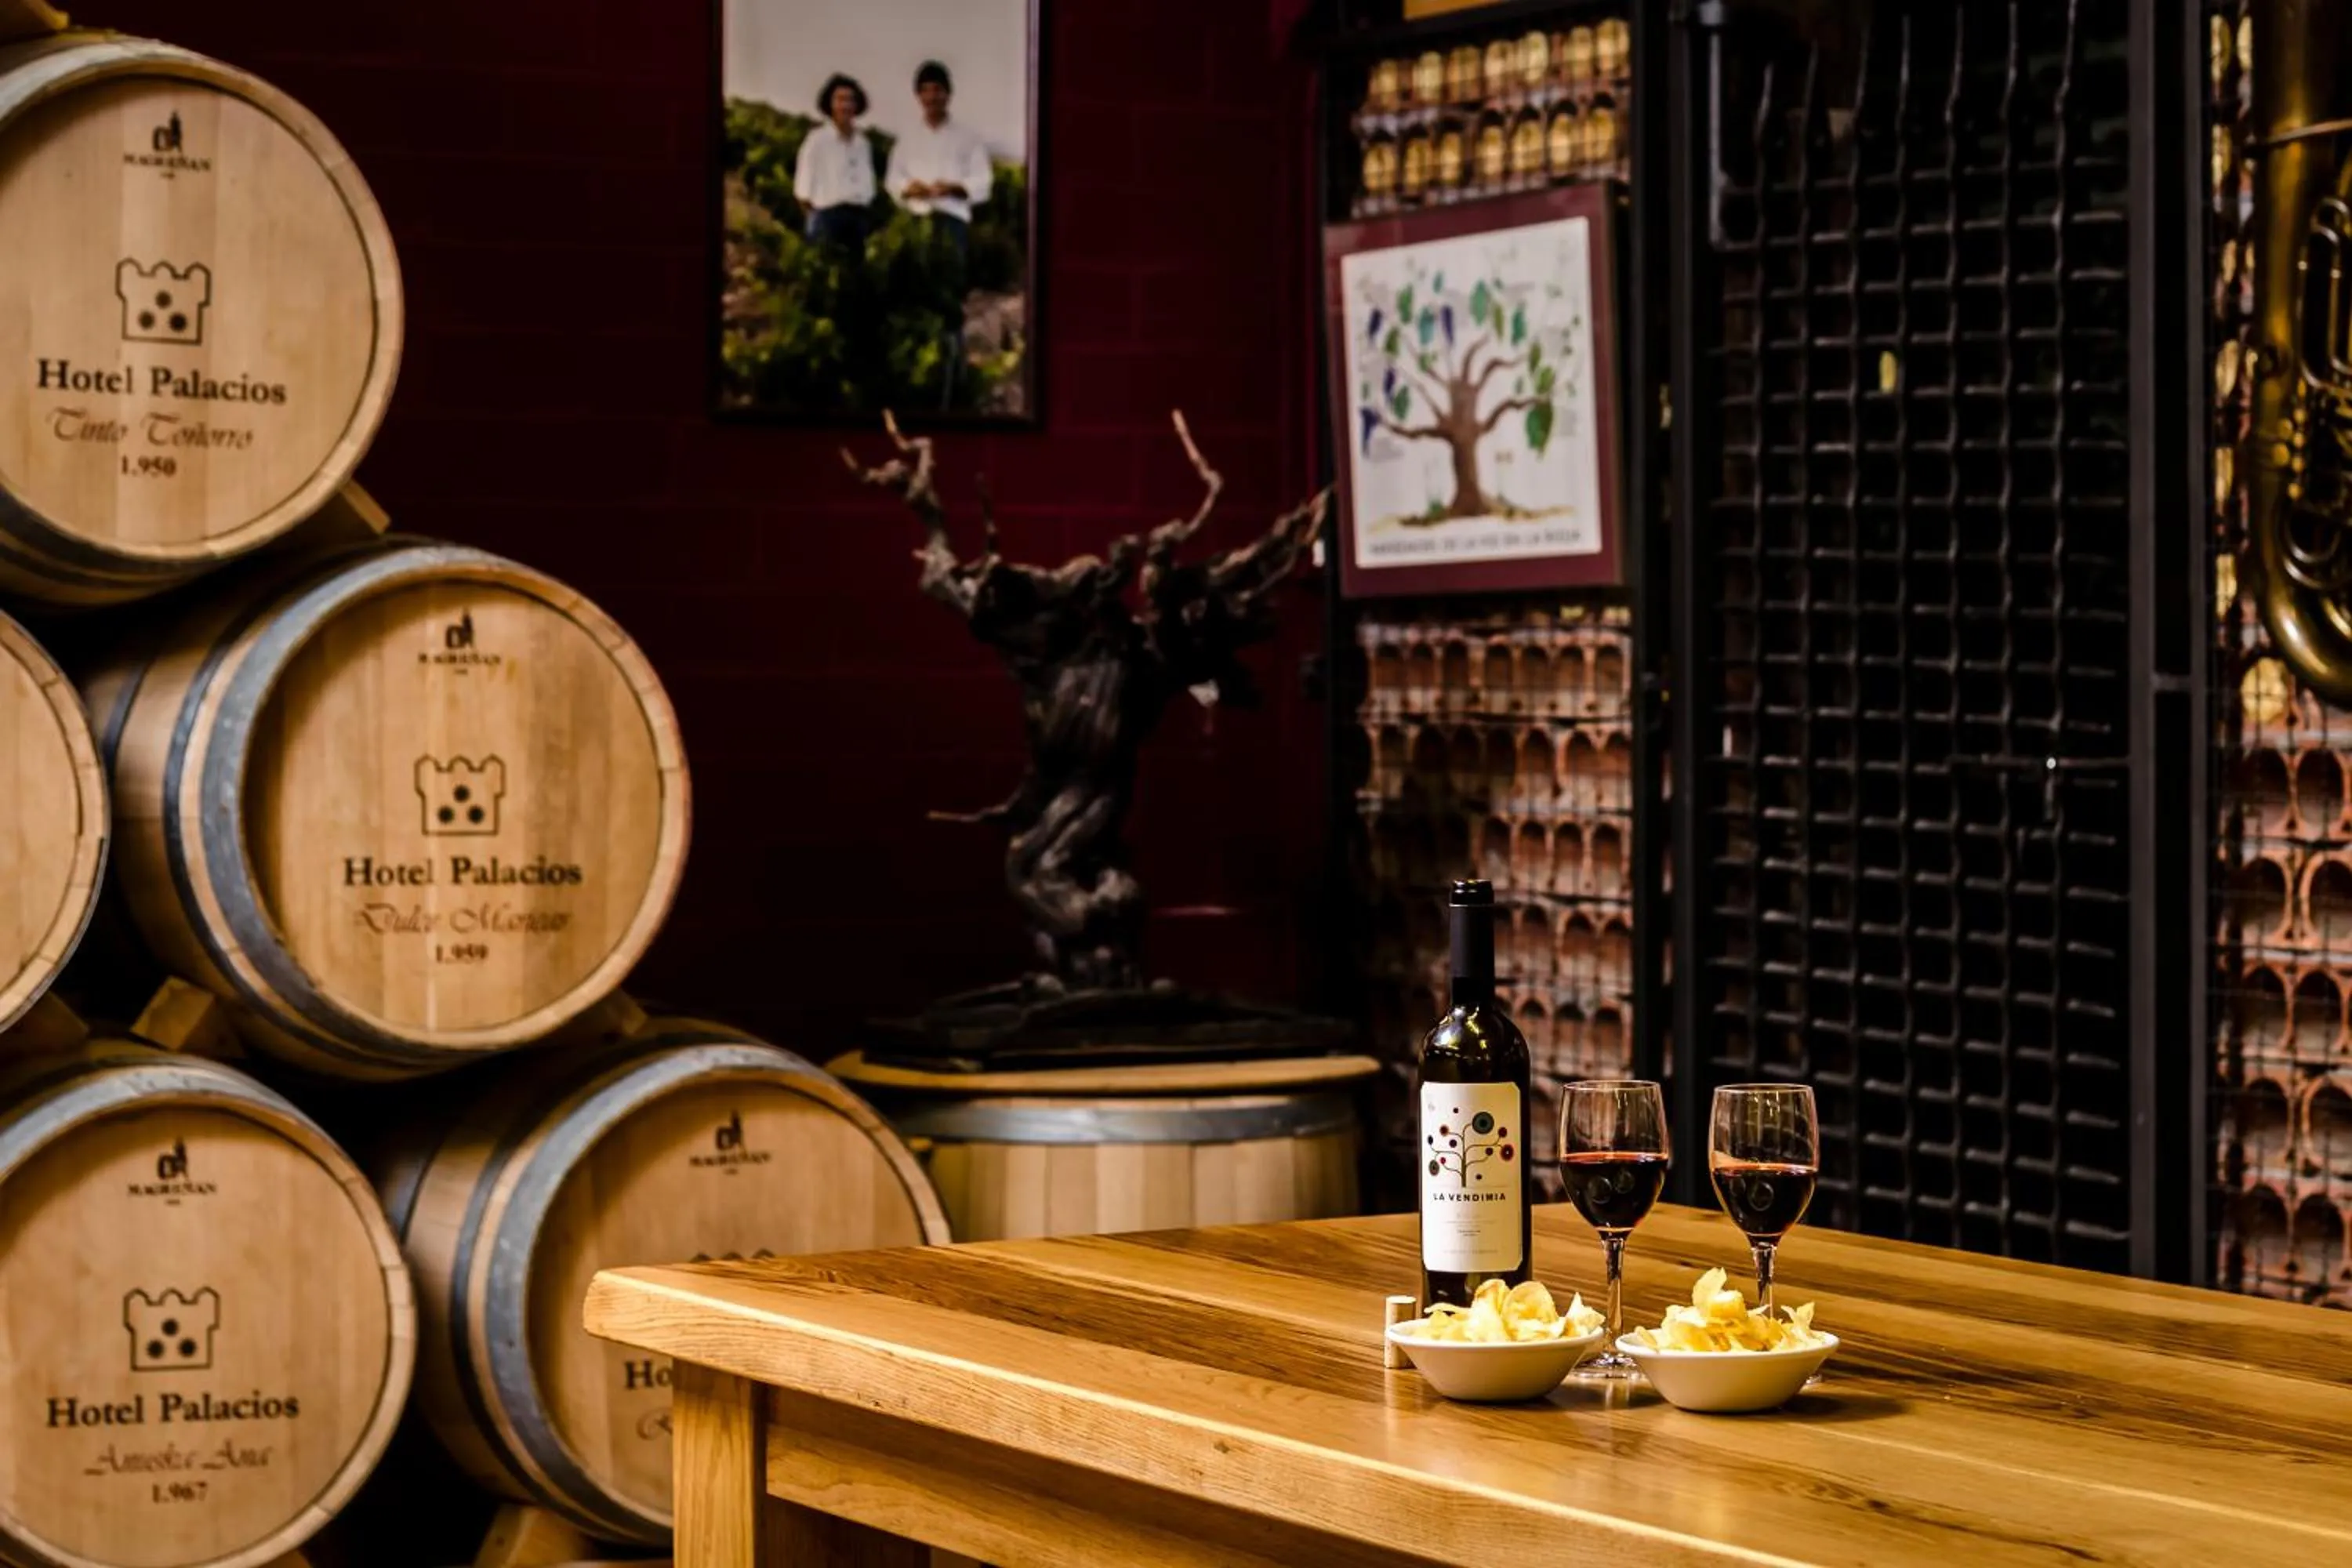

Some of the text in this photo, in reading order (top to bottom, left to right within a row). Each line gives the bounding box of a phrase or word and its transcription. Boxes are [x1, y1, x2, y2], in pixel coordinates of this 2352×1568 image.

[37, 358, 287, 405] Hotel Palacios
[121, 454, 177, 477] 1.950
[344, 854, 583, 887] Hotel Palacios
[1433, 1192, 1506, 1202] LA VENDIMIA
[46, 1388, 300, 1428] Hotel Palacios
